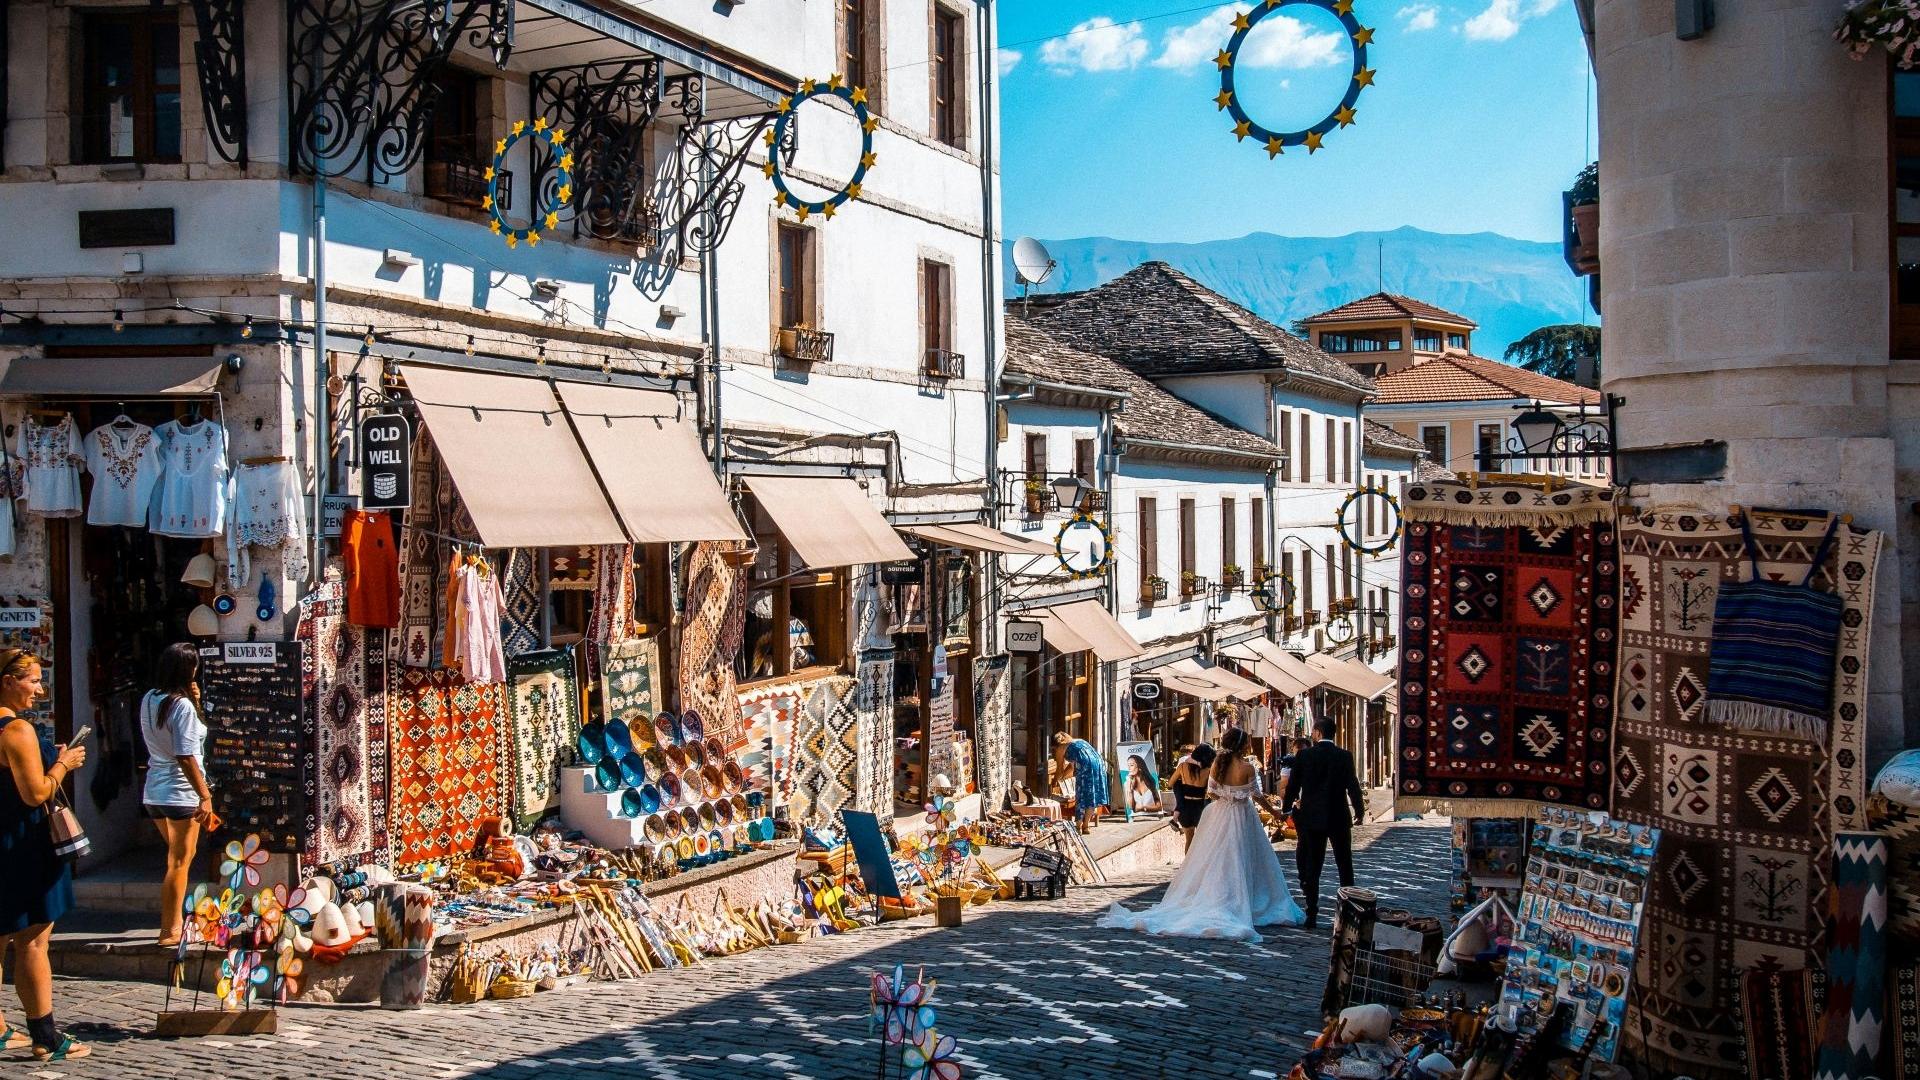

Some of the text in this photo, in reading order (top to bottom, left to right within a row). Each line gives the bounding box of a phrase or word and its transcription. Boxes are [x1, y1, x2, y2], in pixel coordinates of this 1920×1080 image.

[369, 426, 401, 442] OLD
[368, 449, 402, 465] WELL
[228, 646, 257, 658] SILVER
[258, 646, 273, 658] 925
